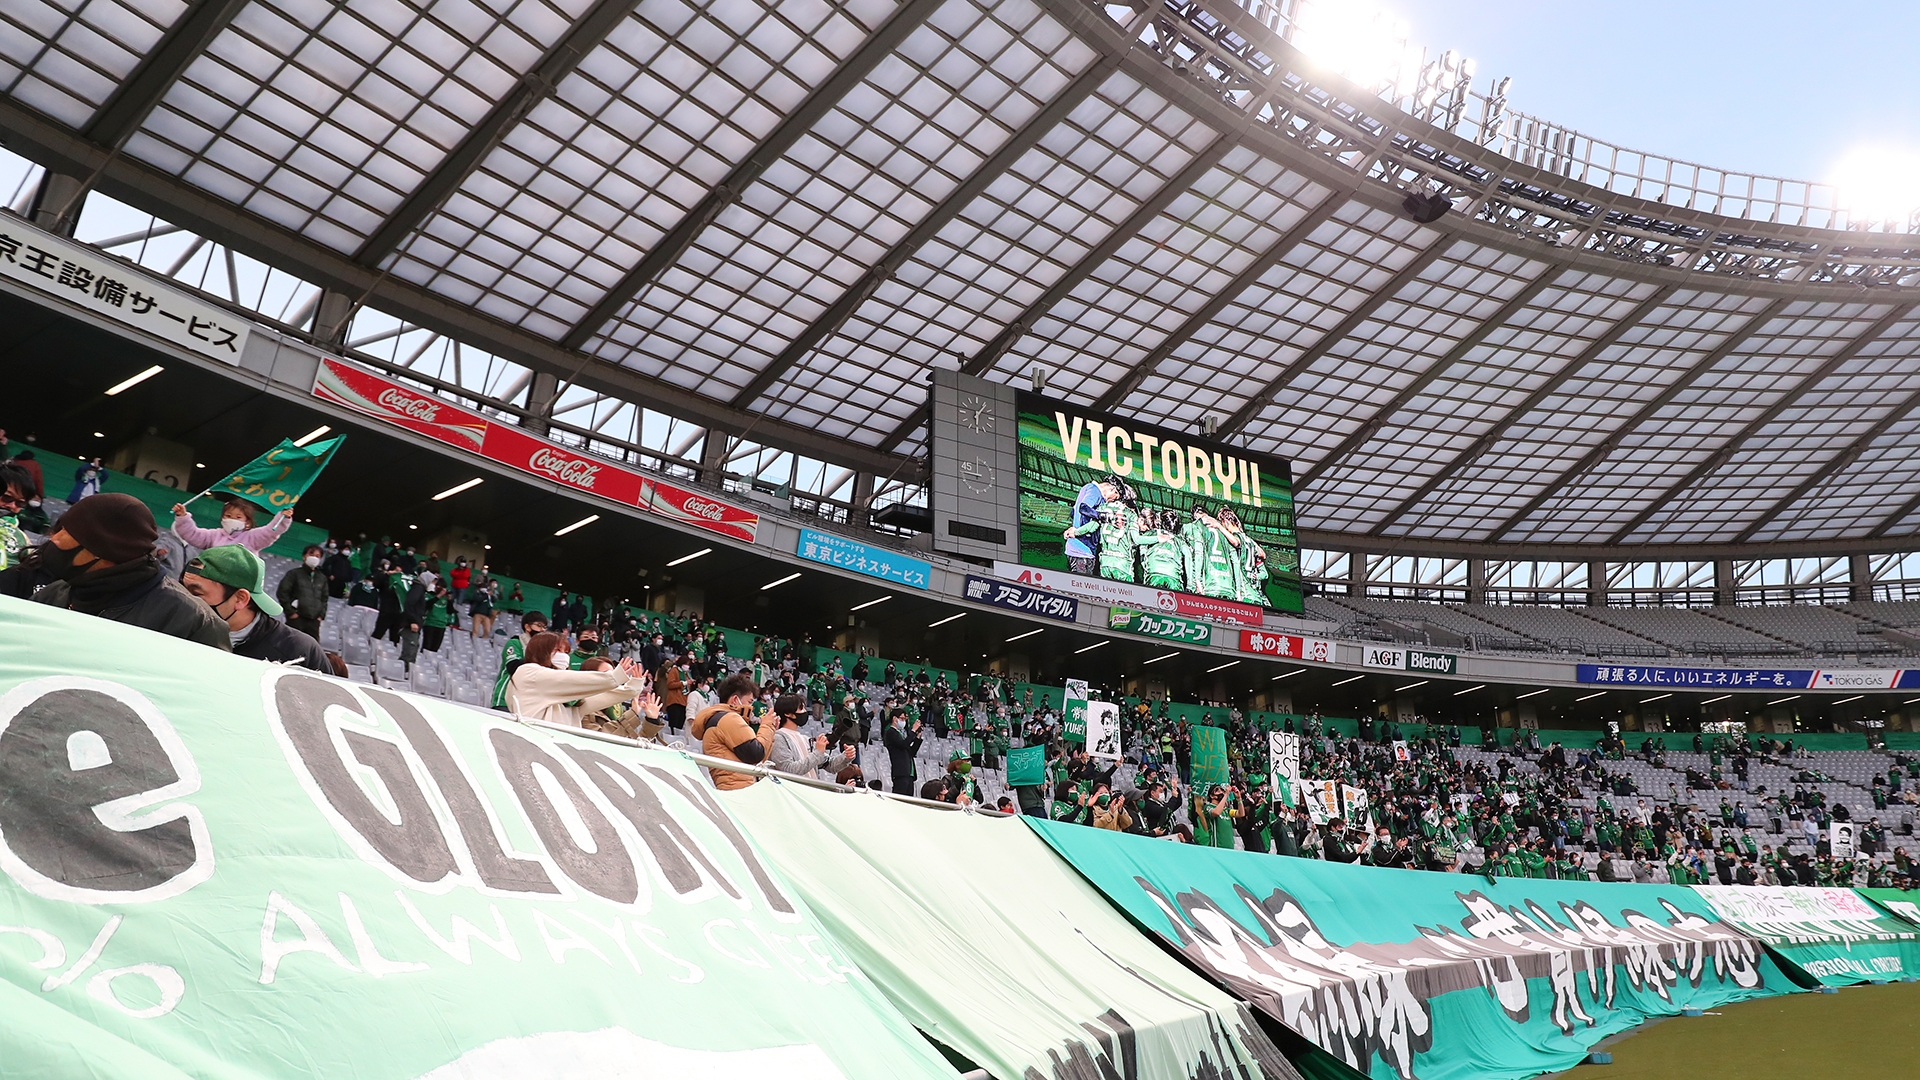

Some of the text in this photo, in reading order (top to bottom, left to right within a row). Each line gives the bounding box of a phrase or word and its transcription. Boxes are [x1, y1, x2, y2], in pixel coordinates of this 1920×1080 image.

[378, 388, 441, 422] Coca-Cola
[529, 448, 602, 487] Coca-Cola
[961, 461, 973, 471] 45
[1054, 411, 1262, 508] VICTORY!!
[803, 542, 924, 586] 東京ビジネスサービス
[968, 579, 990, 592] amino
[1071, 579, 1083, 588] Eat
[1102, 585, 1117, 594] Live
[994, 586, 1072, 618] アミノバイタル
[1137, 615, 1209, 641] カップスープ
[1250, 632, 1290, 656] 味の素
[1368, 650, 1402, 667] AGF
[1410, 652, 1452, 673] Blendy
[1595, 667, 1793, 687] 頑張る人に、いいエネルギーを。
[1834, 677, 1884, 686] TOKYO GAS
[264, 669, 799, 920] GLORY
[257, 890, 706, 985] ALWAYS
